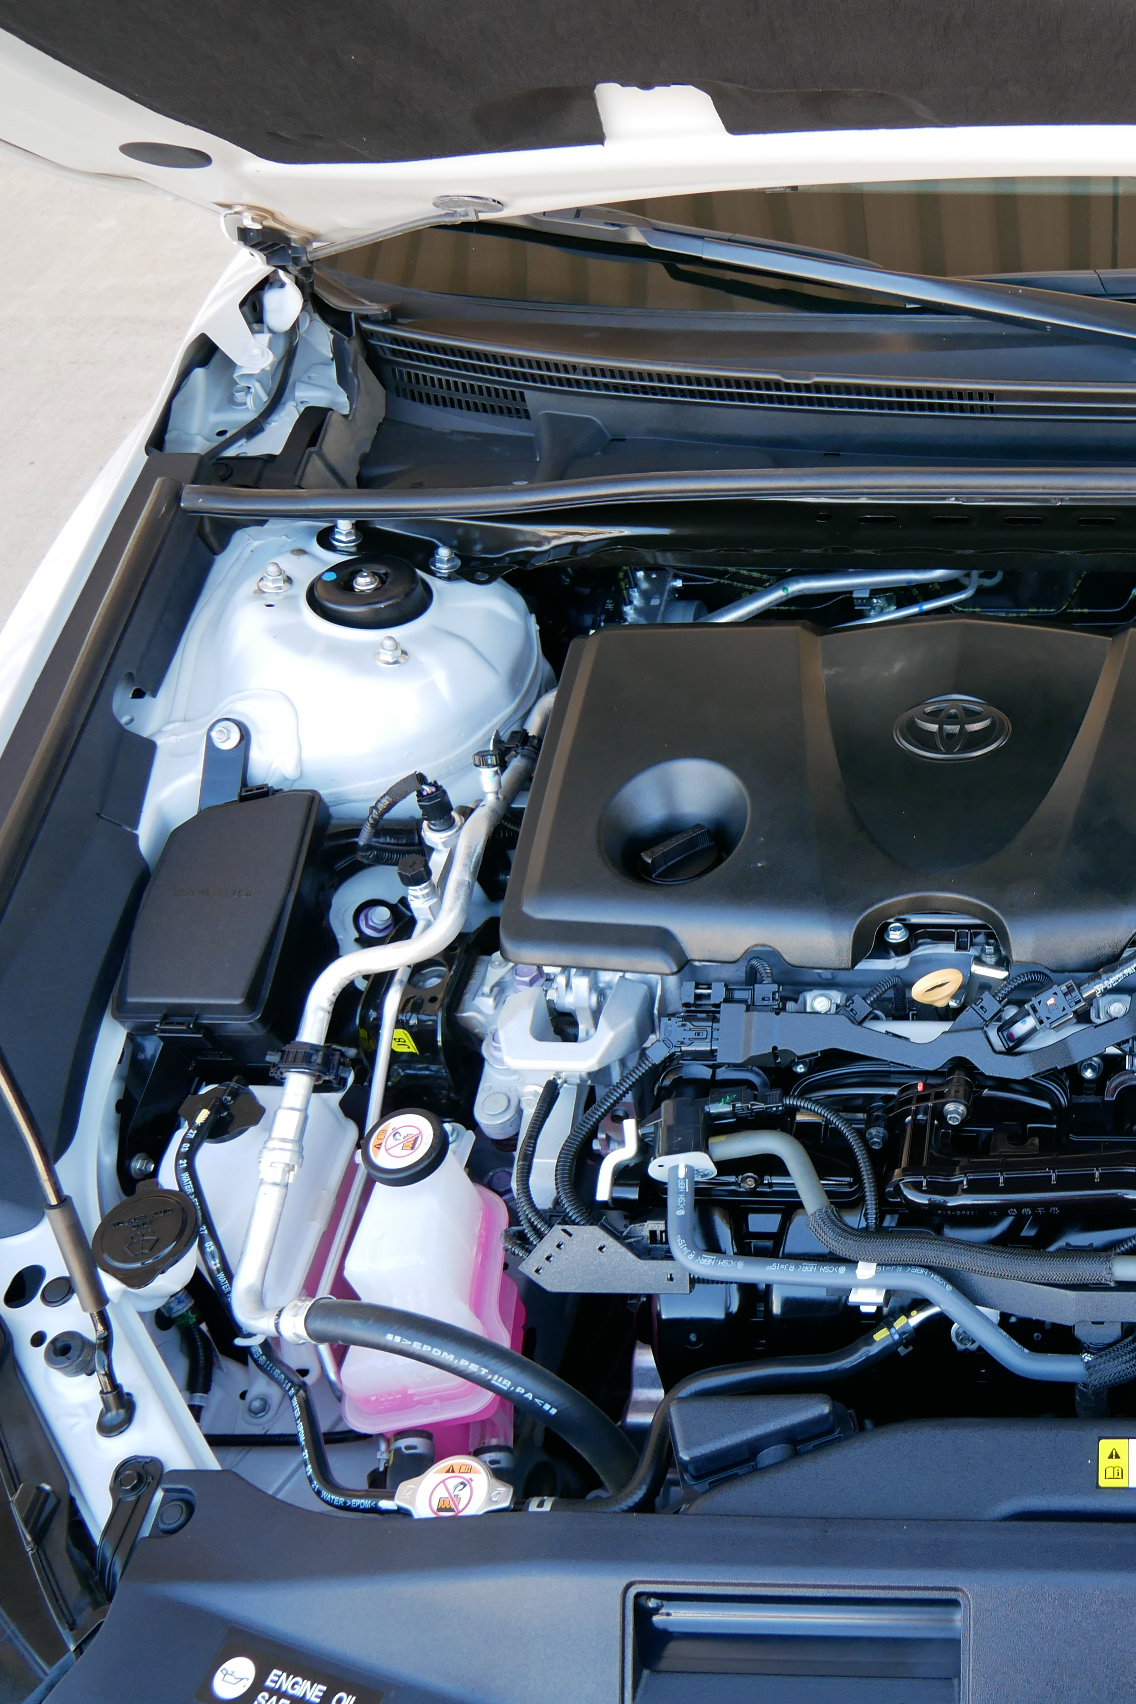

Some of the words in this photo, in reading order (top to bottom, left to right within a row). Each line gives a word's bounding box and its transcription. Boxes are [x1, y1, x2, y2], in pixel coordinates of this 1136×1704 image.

[181, 1171, 194, 1195] WATER
[205, 1241, 215, 1252] 03
[216, 1271, 232, 1294] WATER
[320, 1491, 345, 1506] WATER
[346, 1499, 376, 1509] >EPDM<
[263, 1668, 328, 1704] ENGINE
